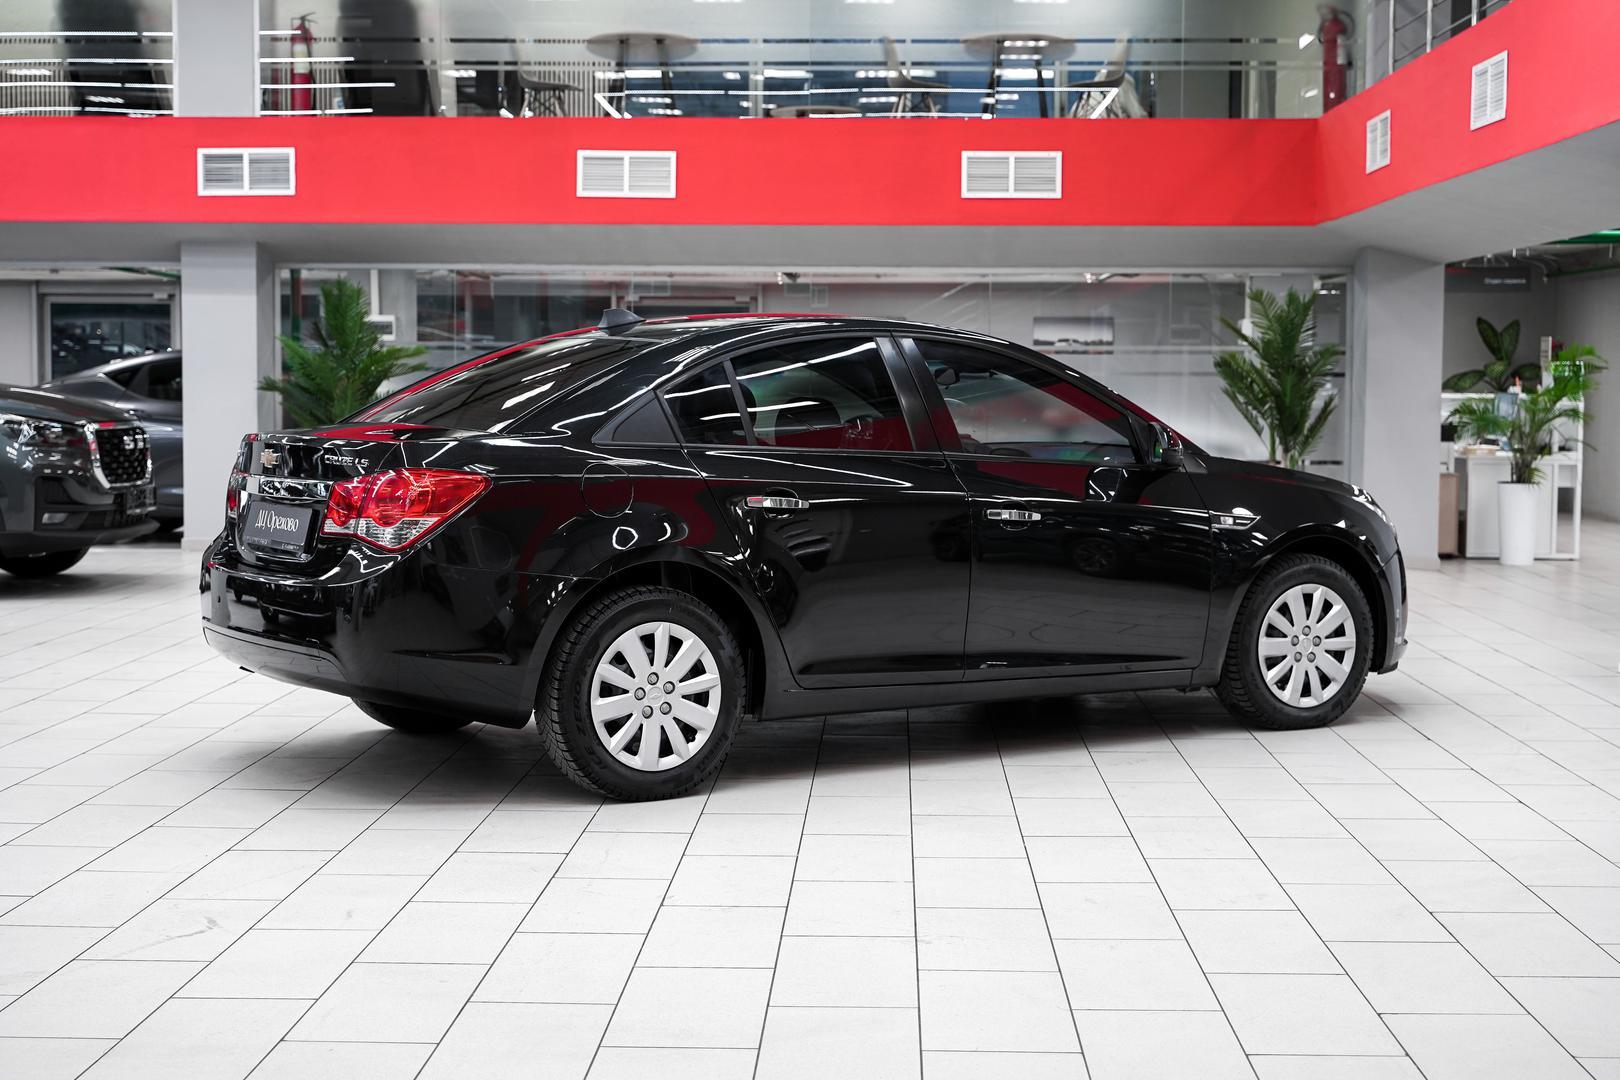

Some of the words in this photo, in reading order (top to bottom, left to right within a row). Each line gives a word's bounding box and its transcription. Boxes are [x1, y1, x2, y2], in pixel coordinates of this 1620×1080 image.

[324, 454, 354, 466] CRUZE
[255, 509, 268, 530] ДЦ
[268, 511, 299, 532] Орехово
[572, 680, 587, 737] ZERO
